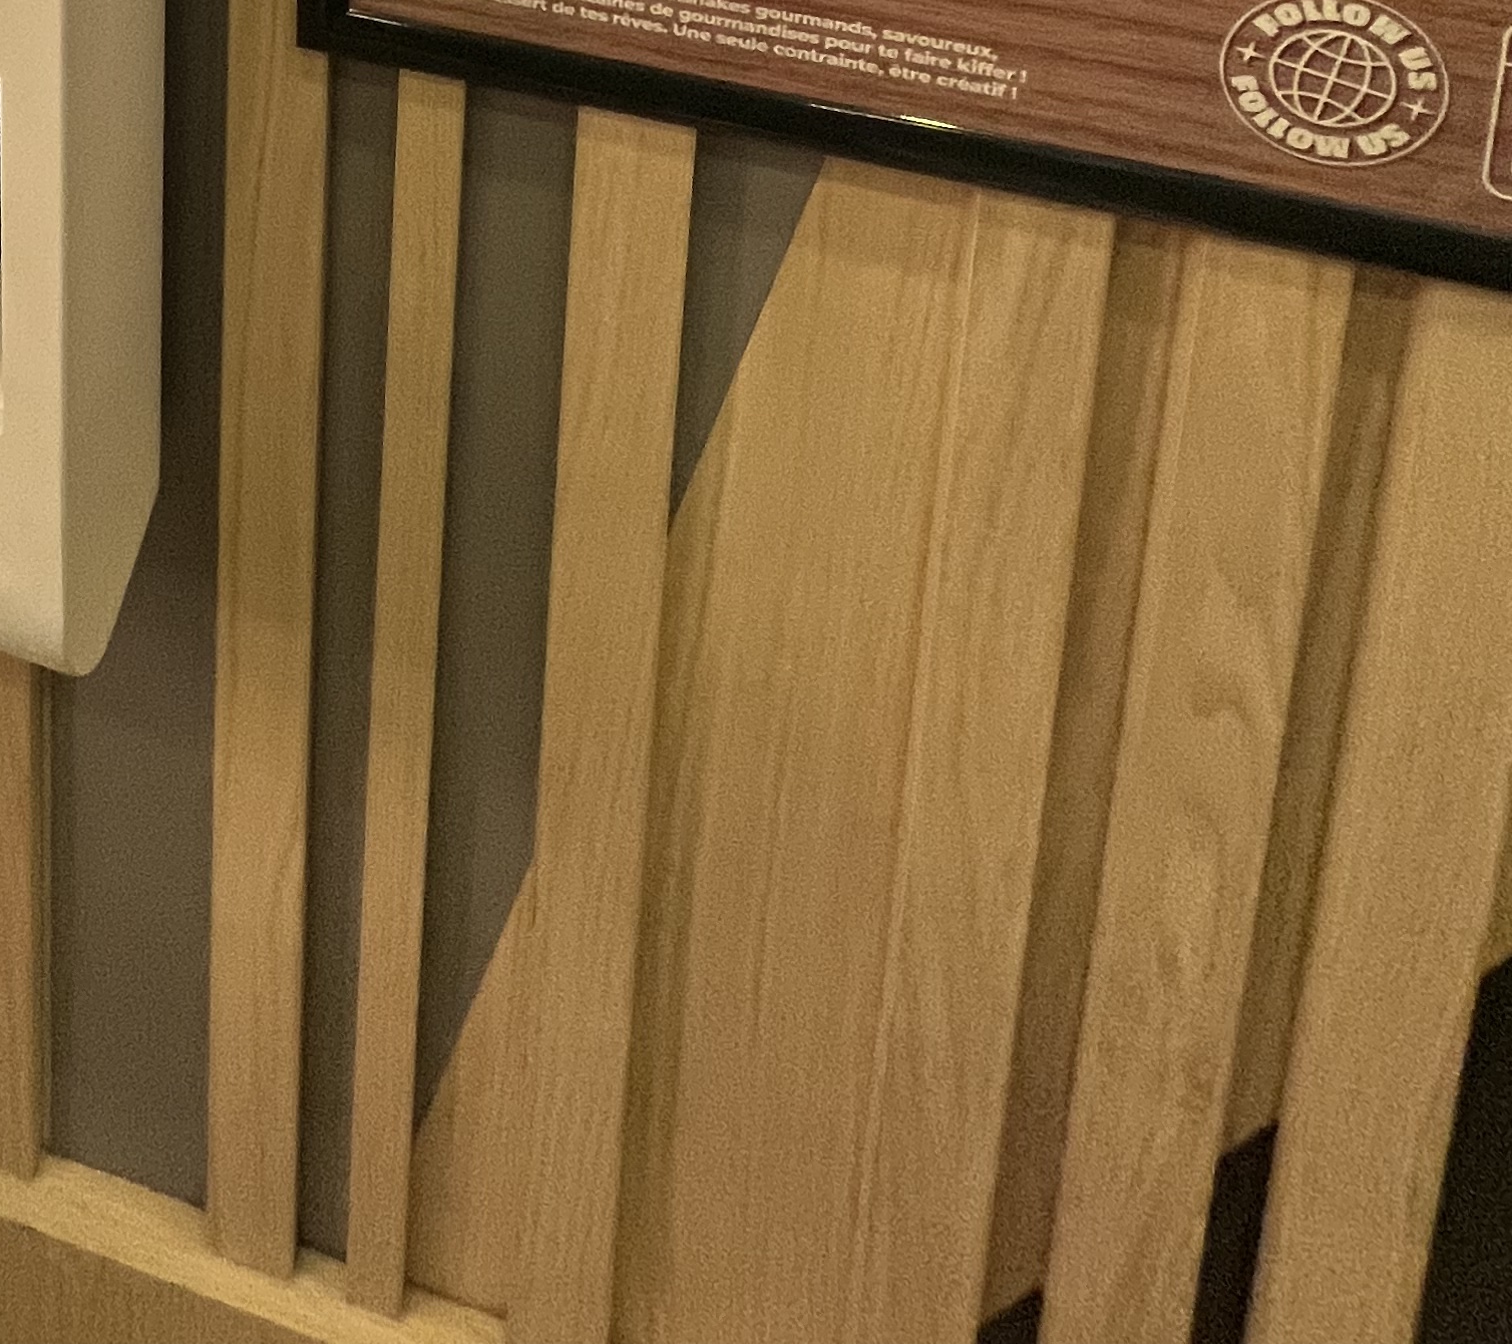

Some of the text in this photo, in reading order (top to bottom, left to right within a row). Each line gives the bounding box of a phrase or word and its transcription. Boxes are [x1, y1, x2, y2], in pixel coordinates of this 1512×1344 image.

[552, 1, 576, 17] de
[580, 6, 609, 24] tes
[612, 11, 669, 33] rêves.
[673, 21, 711, 43] Une
[715, 33, 769, 53] seule
[773, 43, 885, 77] contrainte,
[890, 62, 932, 85] être
[936, 73, 1007, 98] créatif
[650, 1, 674, 18] de
[679, 10, 820, 46] gourmandises
[824, 34, 872, 58] pour
[878, 42, 899, 60] te
[905, 46, 952, 69] faire
[956, 55, 1017, 81] kiffer
[755, 6, 878, 40] gourmands,
[882, 26, 999, 60] savoureux,
[1397, 45, 1438, 92] US
[1230, 74, 1412, 159] FOLLOW US
